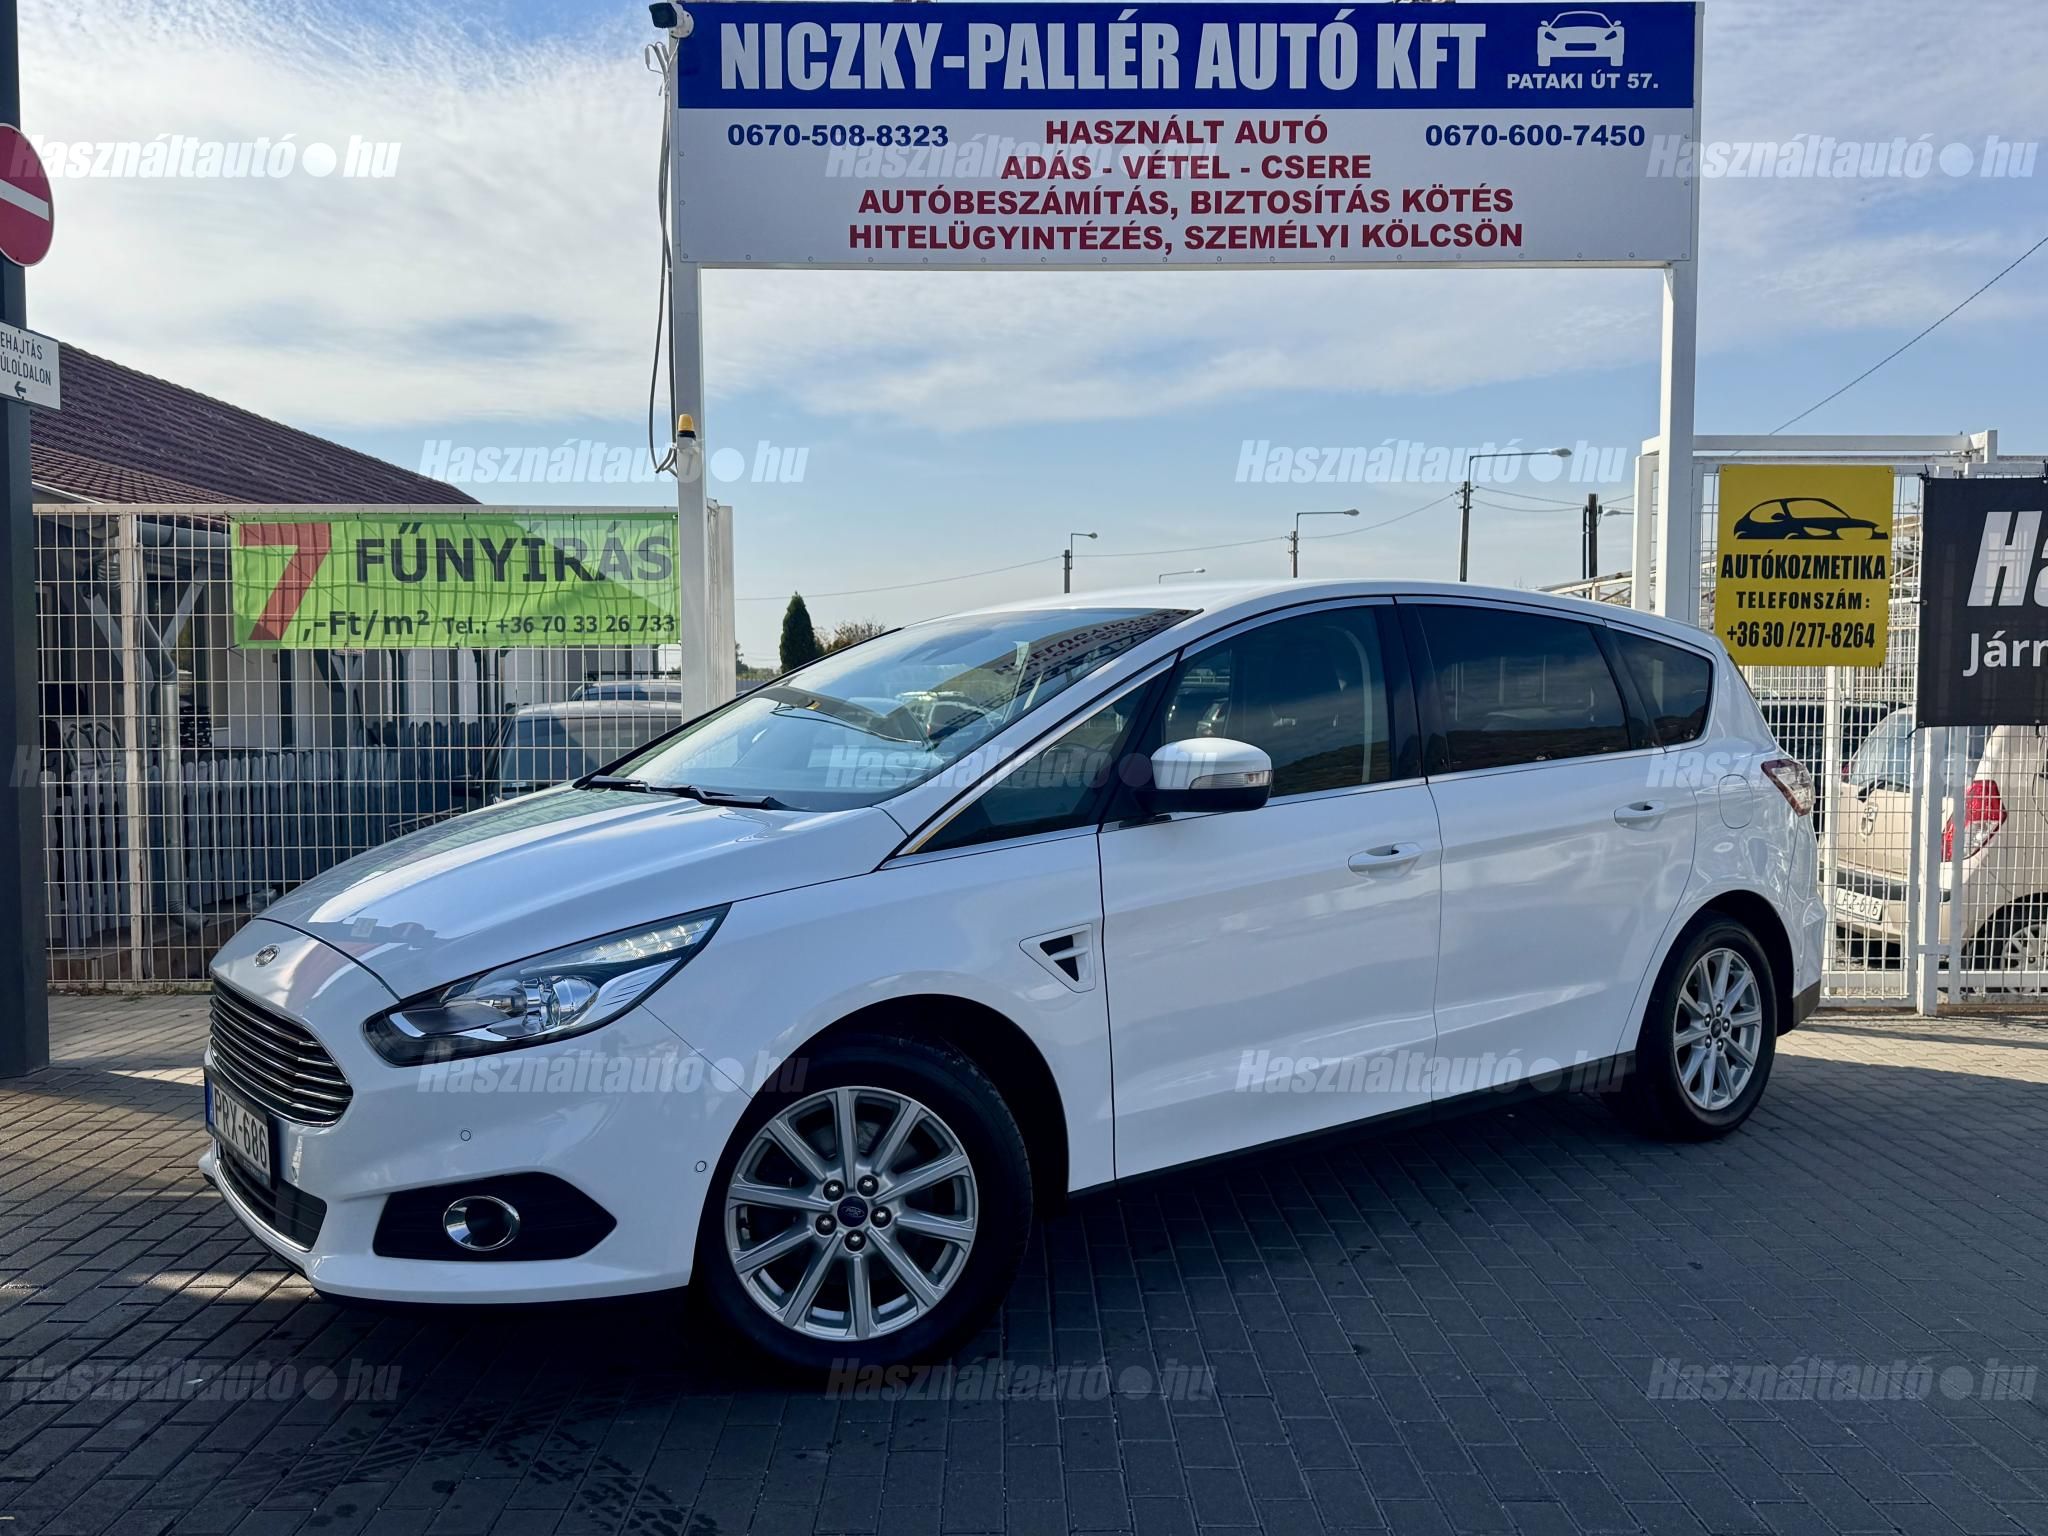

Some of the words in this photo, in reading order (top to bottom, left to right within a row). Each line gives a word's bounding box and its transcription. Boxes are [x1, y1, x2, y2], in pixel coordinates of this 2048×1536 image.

[720, 8, 1180, 91] NICZKY-PALLÉR
[1195, 8, 1359, 91] AUTÓ
[1376, 23, 1487, 90] KFT
[1506, 73, 1584, 90] PATAKI
[1590, 68, 1621, 90] ÚT
[1627, 73, 1660, 90] 57.
[727, 123, 949, 148] 0670-508-8323
[1045, 114, 1225, 145] HASZNÁLT
[1234, 114, 1329, 145] AUTÓ
[1425, 123, 1646, 148] 0670-600-7450
[1000, 148, 1092, 181] ADÁS
[1123, 148, 1230, 181] VÉTEL
[1260, 154, 1372, 180] CSERE
[858, 183, 1178, 220] AUTÓBESZÁMÍTÁS,
[1190, 182, 1390, 216] BIZTOSÍTÁS
[1402, 181, 1514, 214] KÖTÉS
[848, 219, 1173, 256] HITELÜGYINTÉZÉS,
[1184, 217, 1349, 251] SZEMÉLYI
[1362, 219, 1523, 249] KÖLCSÖN
[355, 520, 673, 584] FŰNYÍRÁS
[1721, 549, 1886, 580] AUTÓKOZMETIKA
[239, 522, 332, 641] 7
[442, 616, 488, 635] Tel.:
[496, 615, 534, 635] +36
[541, 615, 566, 634] 70
[573, 615, 598, 633] 33
[605, 614, 631, 633] 26
[637, 614, 676, 633] 733
[214, 1087, 267, 1169] PRX-686
